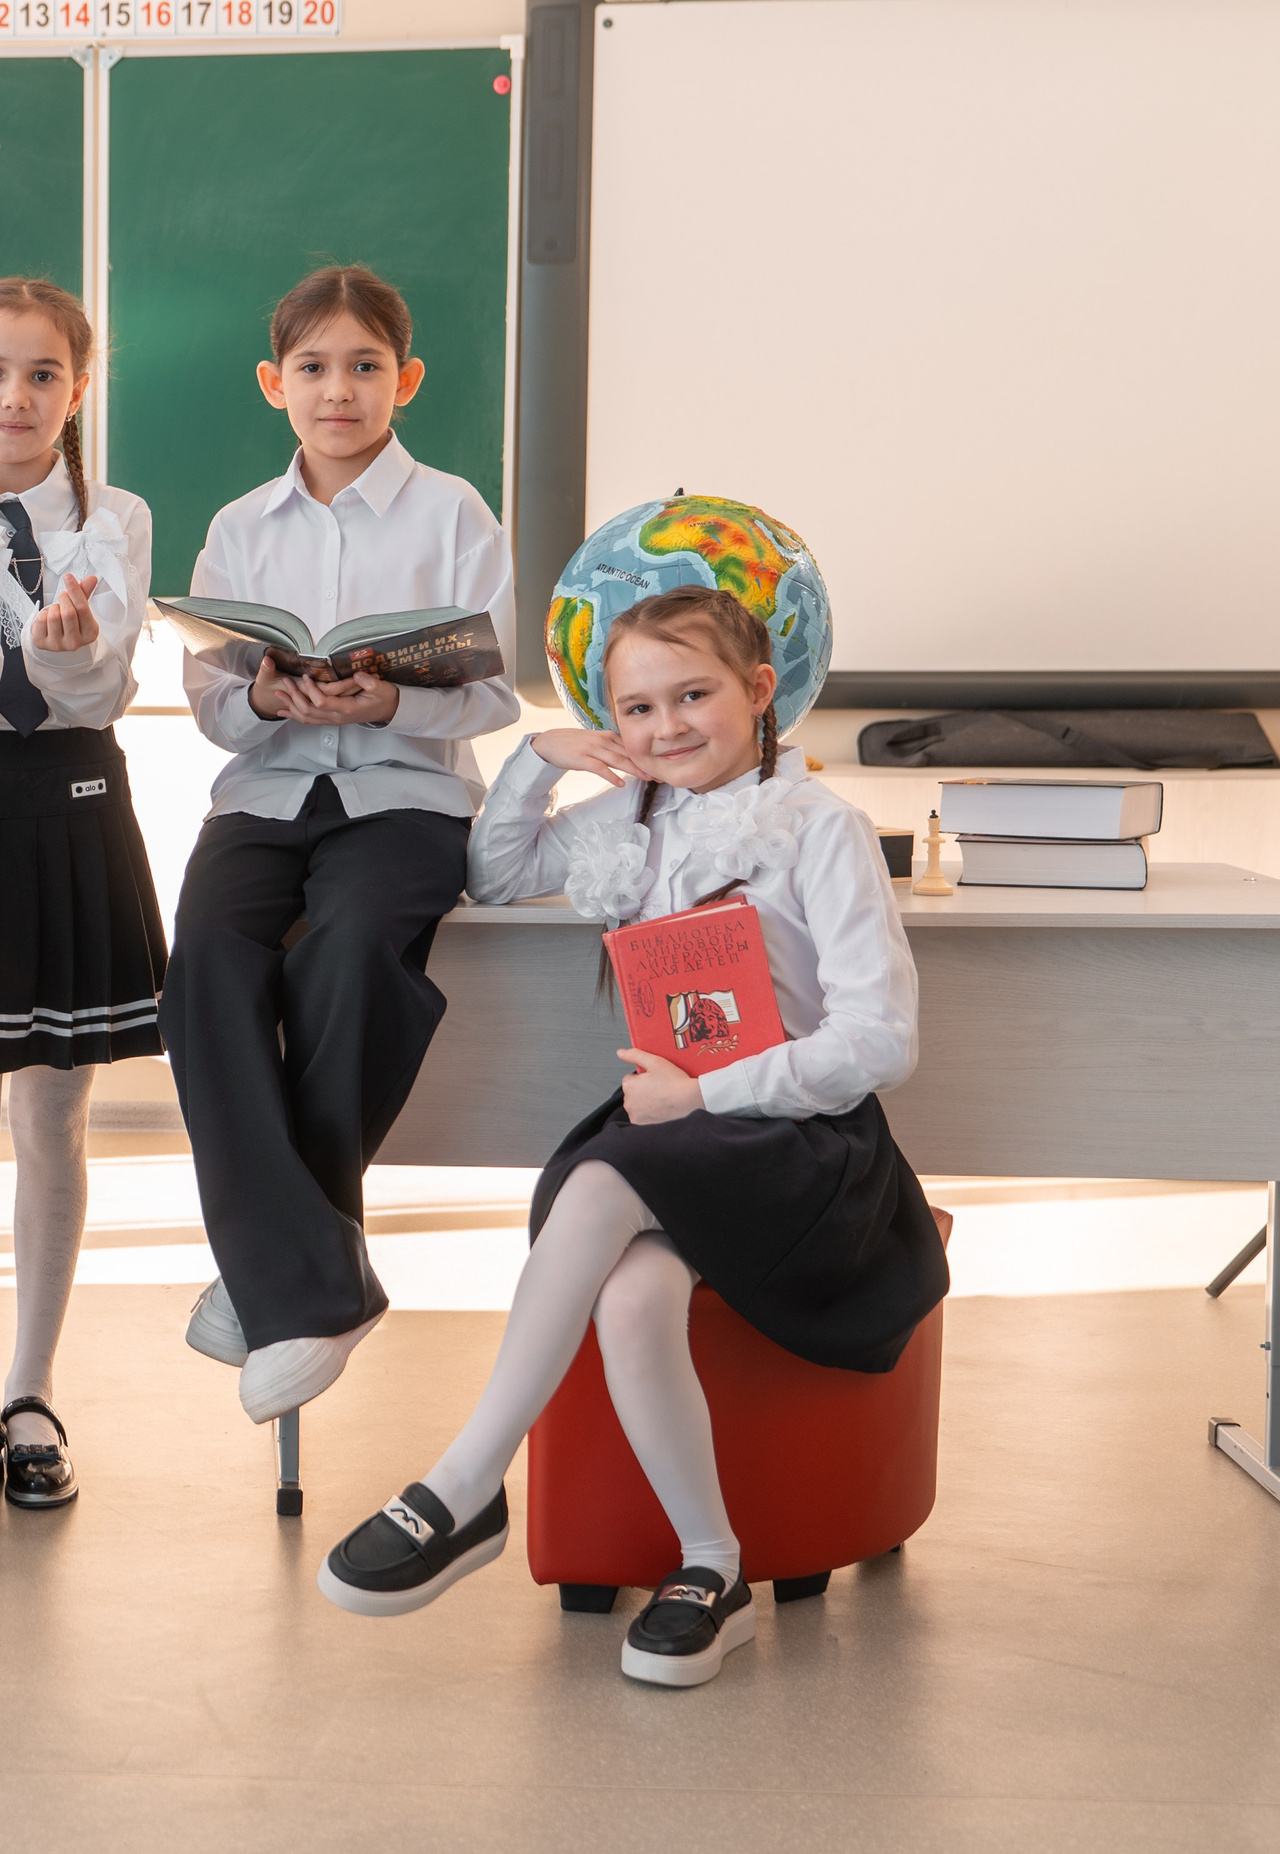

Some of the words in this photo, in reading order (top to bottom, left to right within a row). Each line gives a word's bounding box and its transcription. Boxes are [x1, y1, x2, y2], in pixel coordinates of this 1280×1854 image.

[20, 3, 50, 27] 13
[60, 2, 90, 27] 14
[100, 2, 131, 26] 15
[141, 2, 171, 26] 16
[181, 1, 211, 26] 17
[222, 1, 252, 25] 18
[263, 1, 293, 25] 19
[303, 0, 335, 25] 20
[595, 563, 627, 580] ATLANTIC
[624, 573, 651, 590] OCEAN
[351, 641, 429, 670] ПОДВИГИ
[435, 633, 458, 645] ИХ
[630, 920, 745, 952] БИБЛИОТЕКА
[636, 940, 749, 972] ЛИТЕРАТУРЫ
[649, 963, 679, 980] ДЛЯ
[684, 952, 740, 974] ДЕТЕЙ
